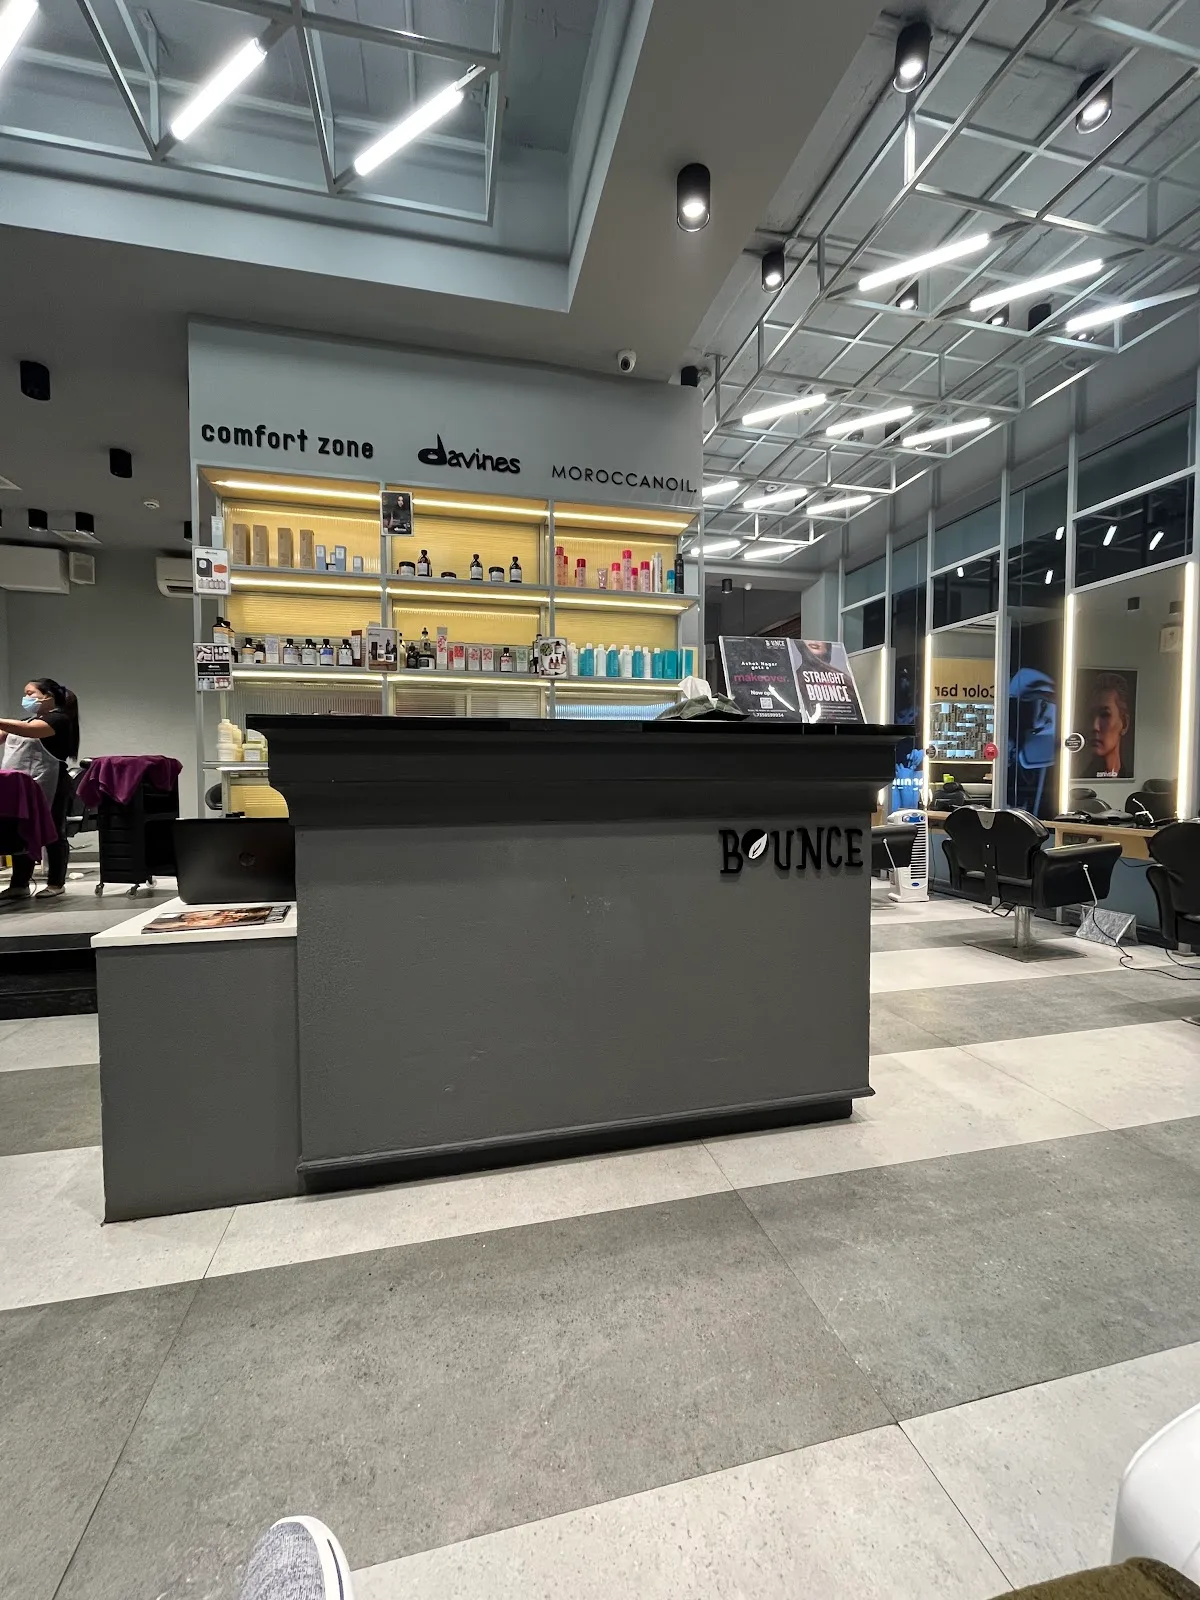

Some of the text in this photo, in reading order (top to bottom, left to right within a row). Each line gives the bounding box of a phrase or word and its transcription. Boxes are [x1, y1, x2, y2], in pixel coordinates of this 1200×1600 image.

[201, 423, 373, 459] comfort zone
[418, 433, 521, 474] davines
[802, 670, 845, 684] STRAIGHT
[806, 684, 852, 702] BOUNCE
[718, 826, 864, 874] BOUNCE
